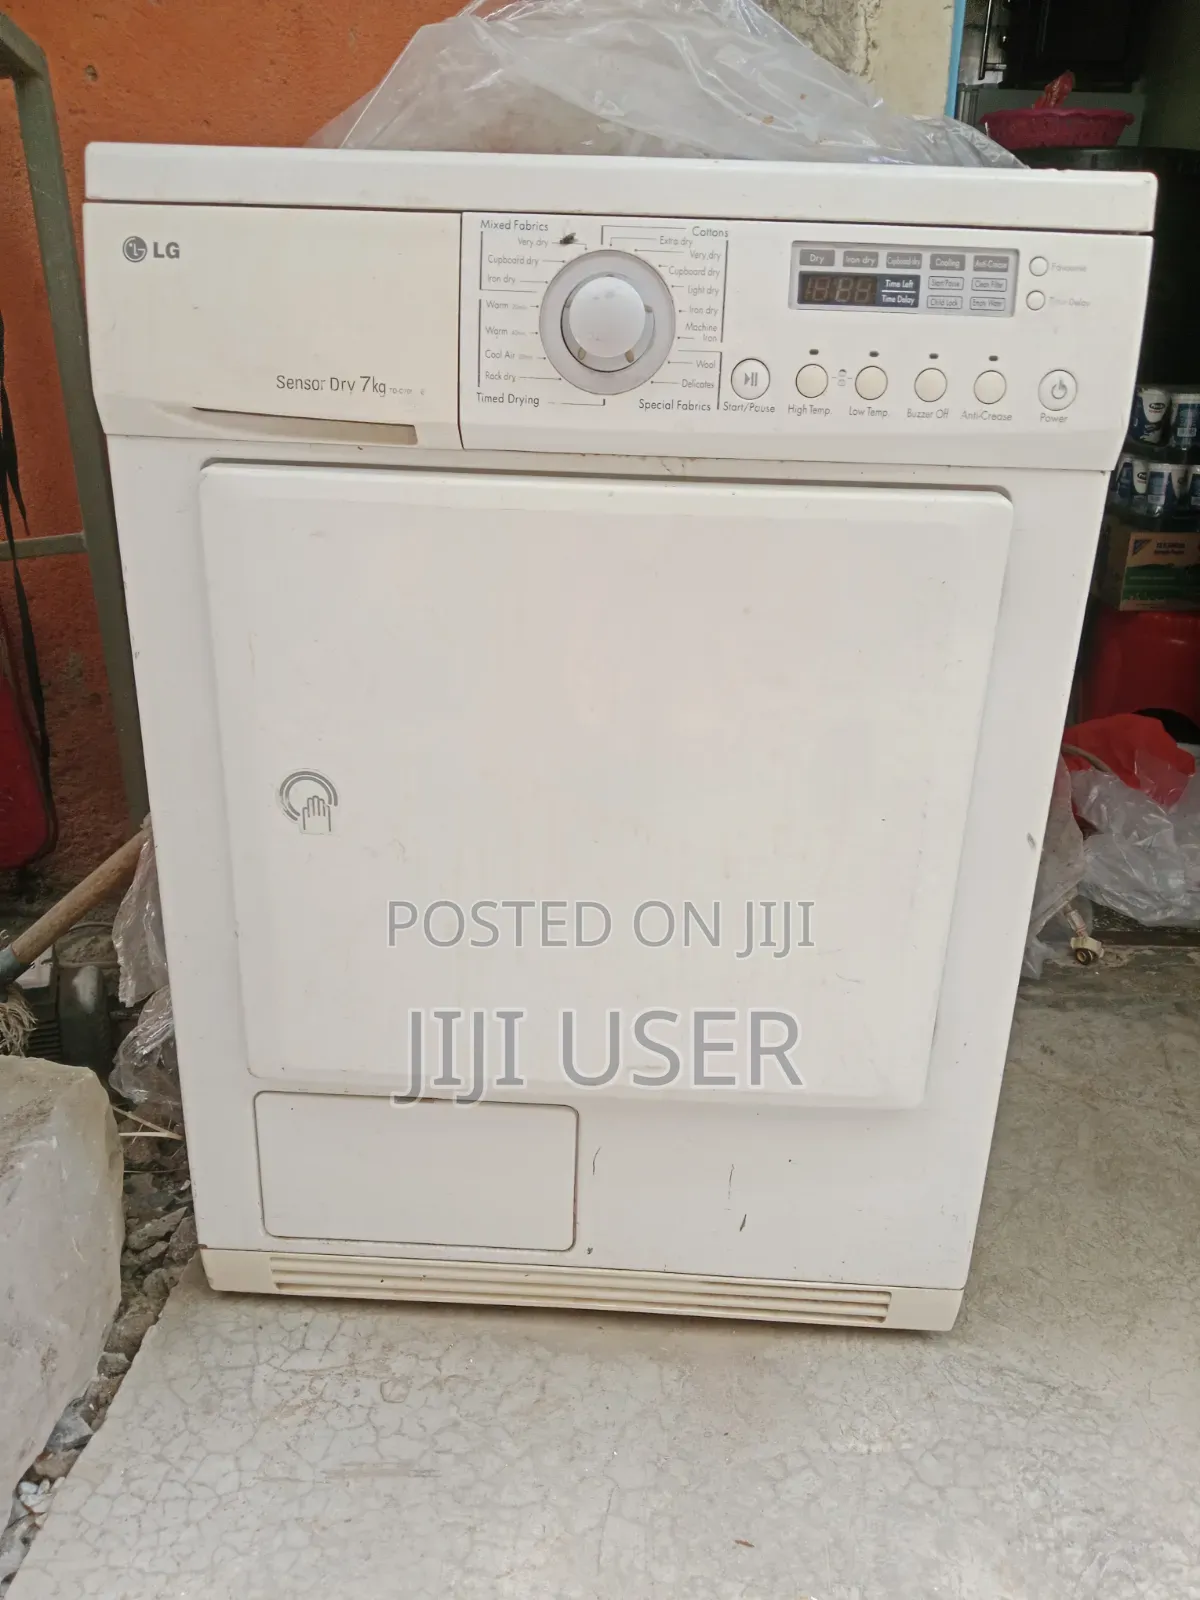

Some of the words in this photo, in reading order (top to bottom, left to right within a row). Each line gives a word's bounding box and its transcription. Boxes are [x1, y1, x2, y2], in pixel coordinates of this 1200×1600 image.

[480, 219, 511, 231] Mixed
[514, 219, 549, 231] Fabrics
[692, 225, 729, 238] Cottons
[518, 237, 534, 248] Very
[536, 238, 549, 248] dry
[660, 235, 679, 246] Extra
[680, 236, 693, 248] dry
[152, 241, 180, 259] LG
[690, 249, 707, 260] Very
[708, 250, 721, 262] dry
[487, 254, 525, 266] Cupboard
[526, 255, 540, 267] dry
[809, 253, 825, 264] Dry
[845, 255, 860, 264] Iron
[862, 255, 877, 267] dry
[935, 257, 961, 269] Cooling
[668, 265, 706, 278] Cupboard
[707, 267, 721, 280] dry
[487, 274, 501, 283] Iron
[503, 274, 516, 285] dry
[885, 279, 901, 288] Time
[902, 279, 915, 289] Left
[687, 284, 705, 297] Light
[706, 285, 720, 297] dry
[486, 300, 509, 309] Warm
[881, 294, 897, 304] Time
[897, 295, 915, 306] Delay
[689, 304, 704, 314] Iron
[705, 304, 719, 317] dry
[485, 326, 508, 336] Warm
[685, 321, 718, 333] Machine
[703, 332, 717, 342] Iron
[485, 349, 502, 359] Cool
[504, 349, 516, 360] Air
[696, 360, 716, 369] Wool
[503, 371, 516, 383] dry
[276, 374, 326, 391] Sensor
[359, 375, 386, 398] 7kg
[682, 378, 714, 390] Delicates
[477, 391, 504, 404] Timed
[507, 393, 540, 408] Drying
[638, 398, 674, 412] Special
[676, 399, 711, 412] Fabrics
[722, 401, 776, 414] Start/Pause
[787, 403, 808, 417] High
[809, 404, 833, 417] Temp.
[848, 405, 866, 417] Low
[867, 406, 890, 418] Temp.
[906, 407, 934, 419] Buzzer
[935, 408, 950, 420] Off
[960, 409, 1013, 422] Anti-Crease
[1039, 412, 1069, 424] Power
